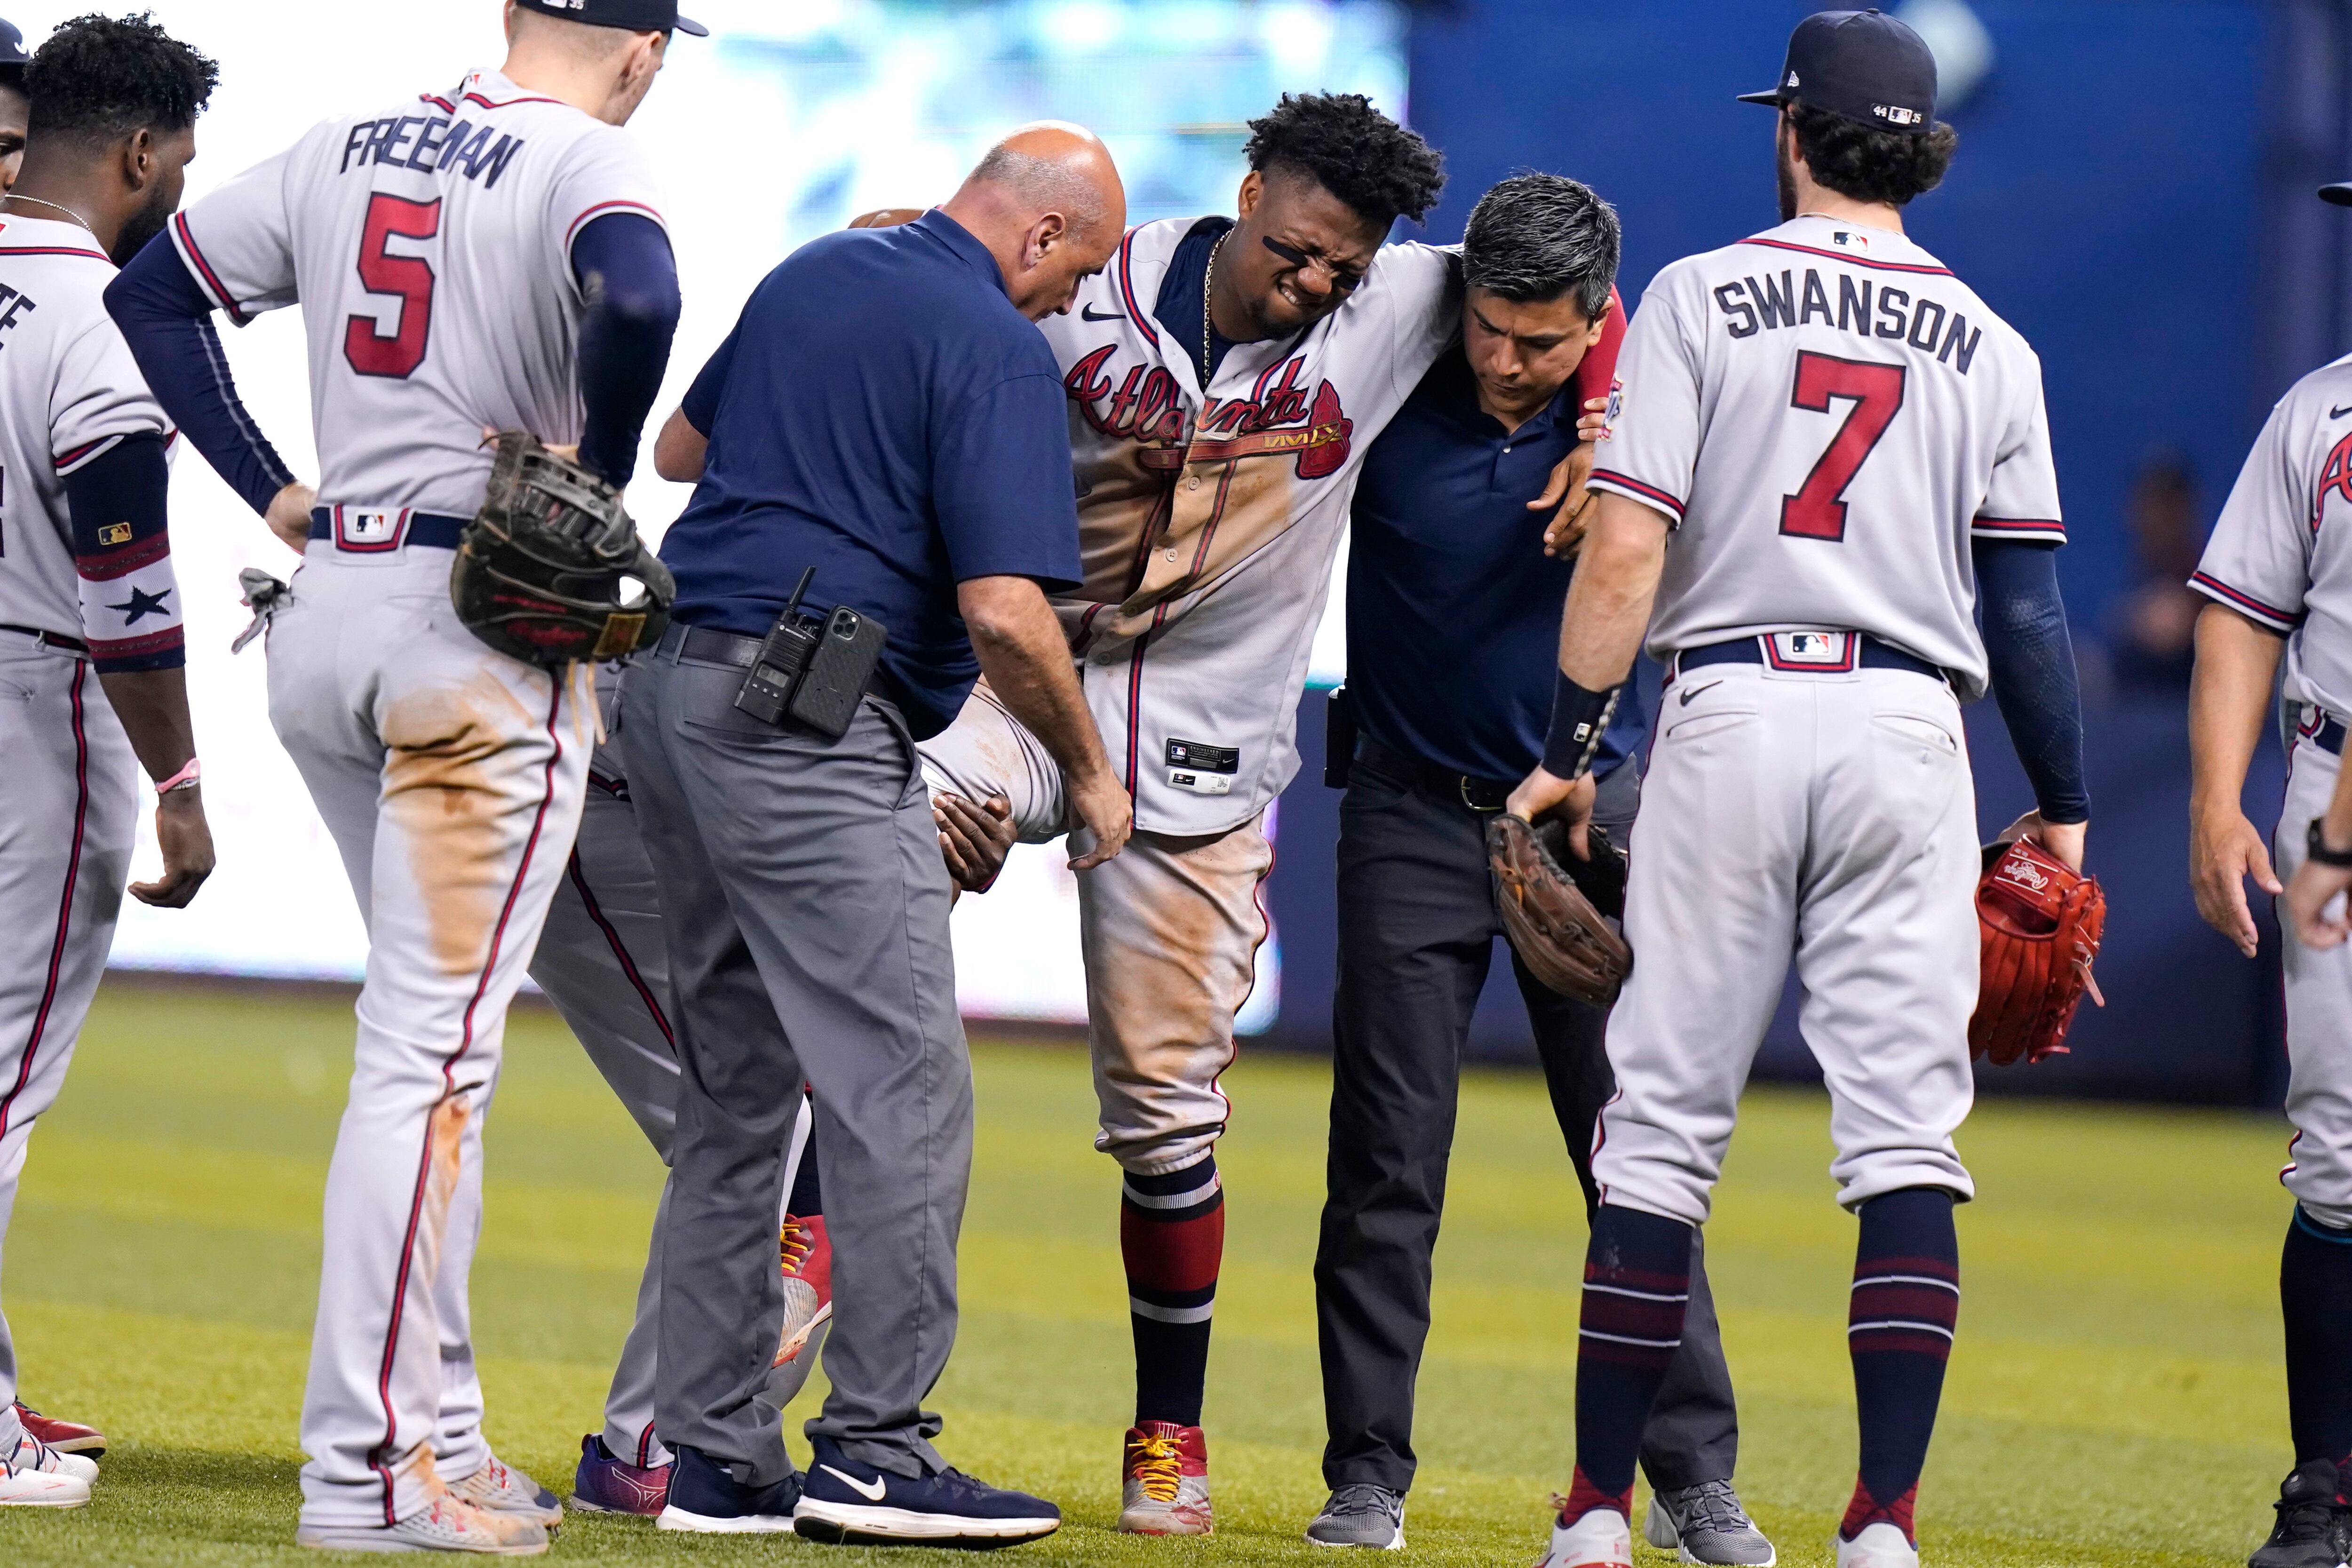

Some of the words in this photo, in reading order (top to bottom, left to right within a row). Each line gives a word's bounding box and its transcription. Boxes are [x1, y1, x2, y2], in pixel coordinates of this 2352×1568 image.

[1873, 106, 1887, 117] 44
[343, 191, 443, 379] 5
[1714, 269, 1982, 375] SWANSON
[1065, 343, 1310, 441] Atlanta
[1779, 349, 1906, 542] 7
[2004, 861, 2049, 889] Rawlings
